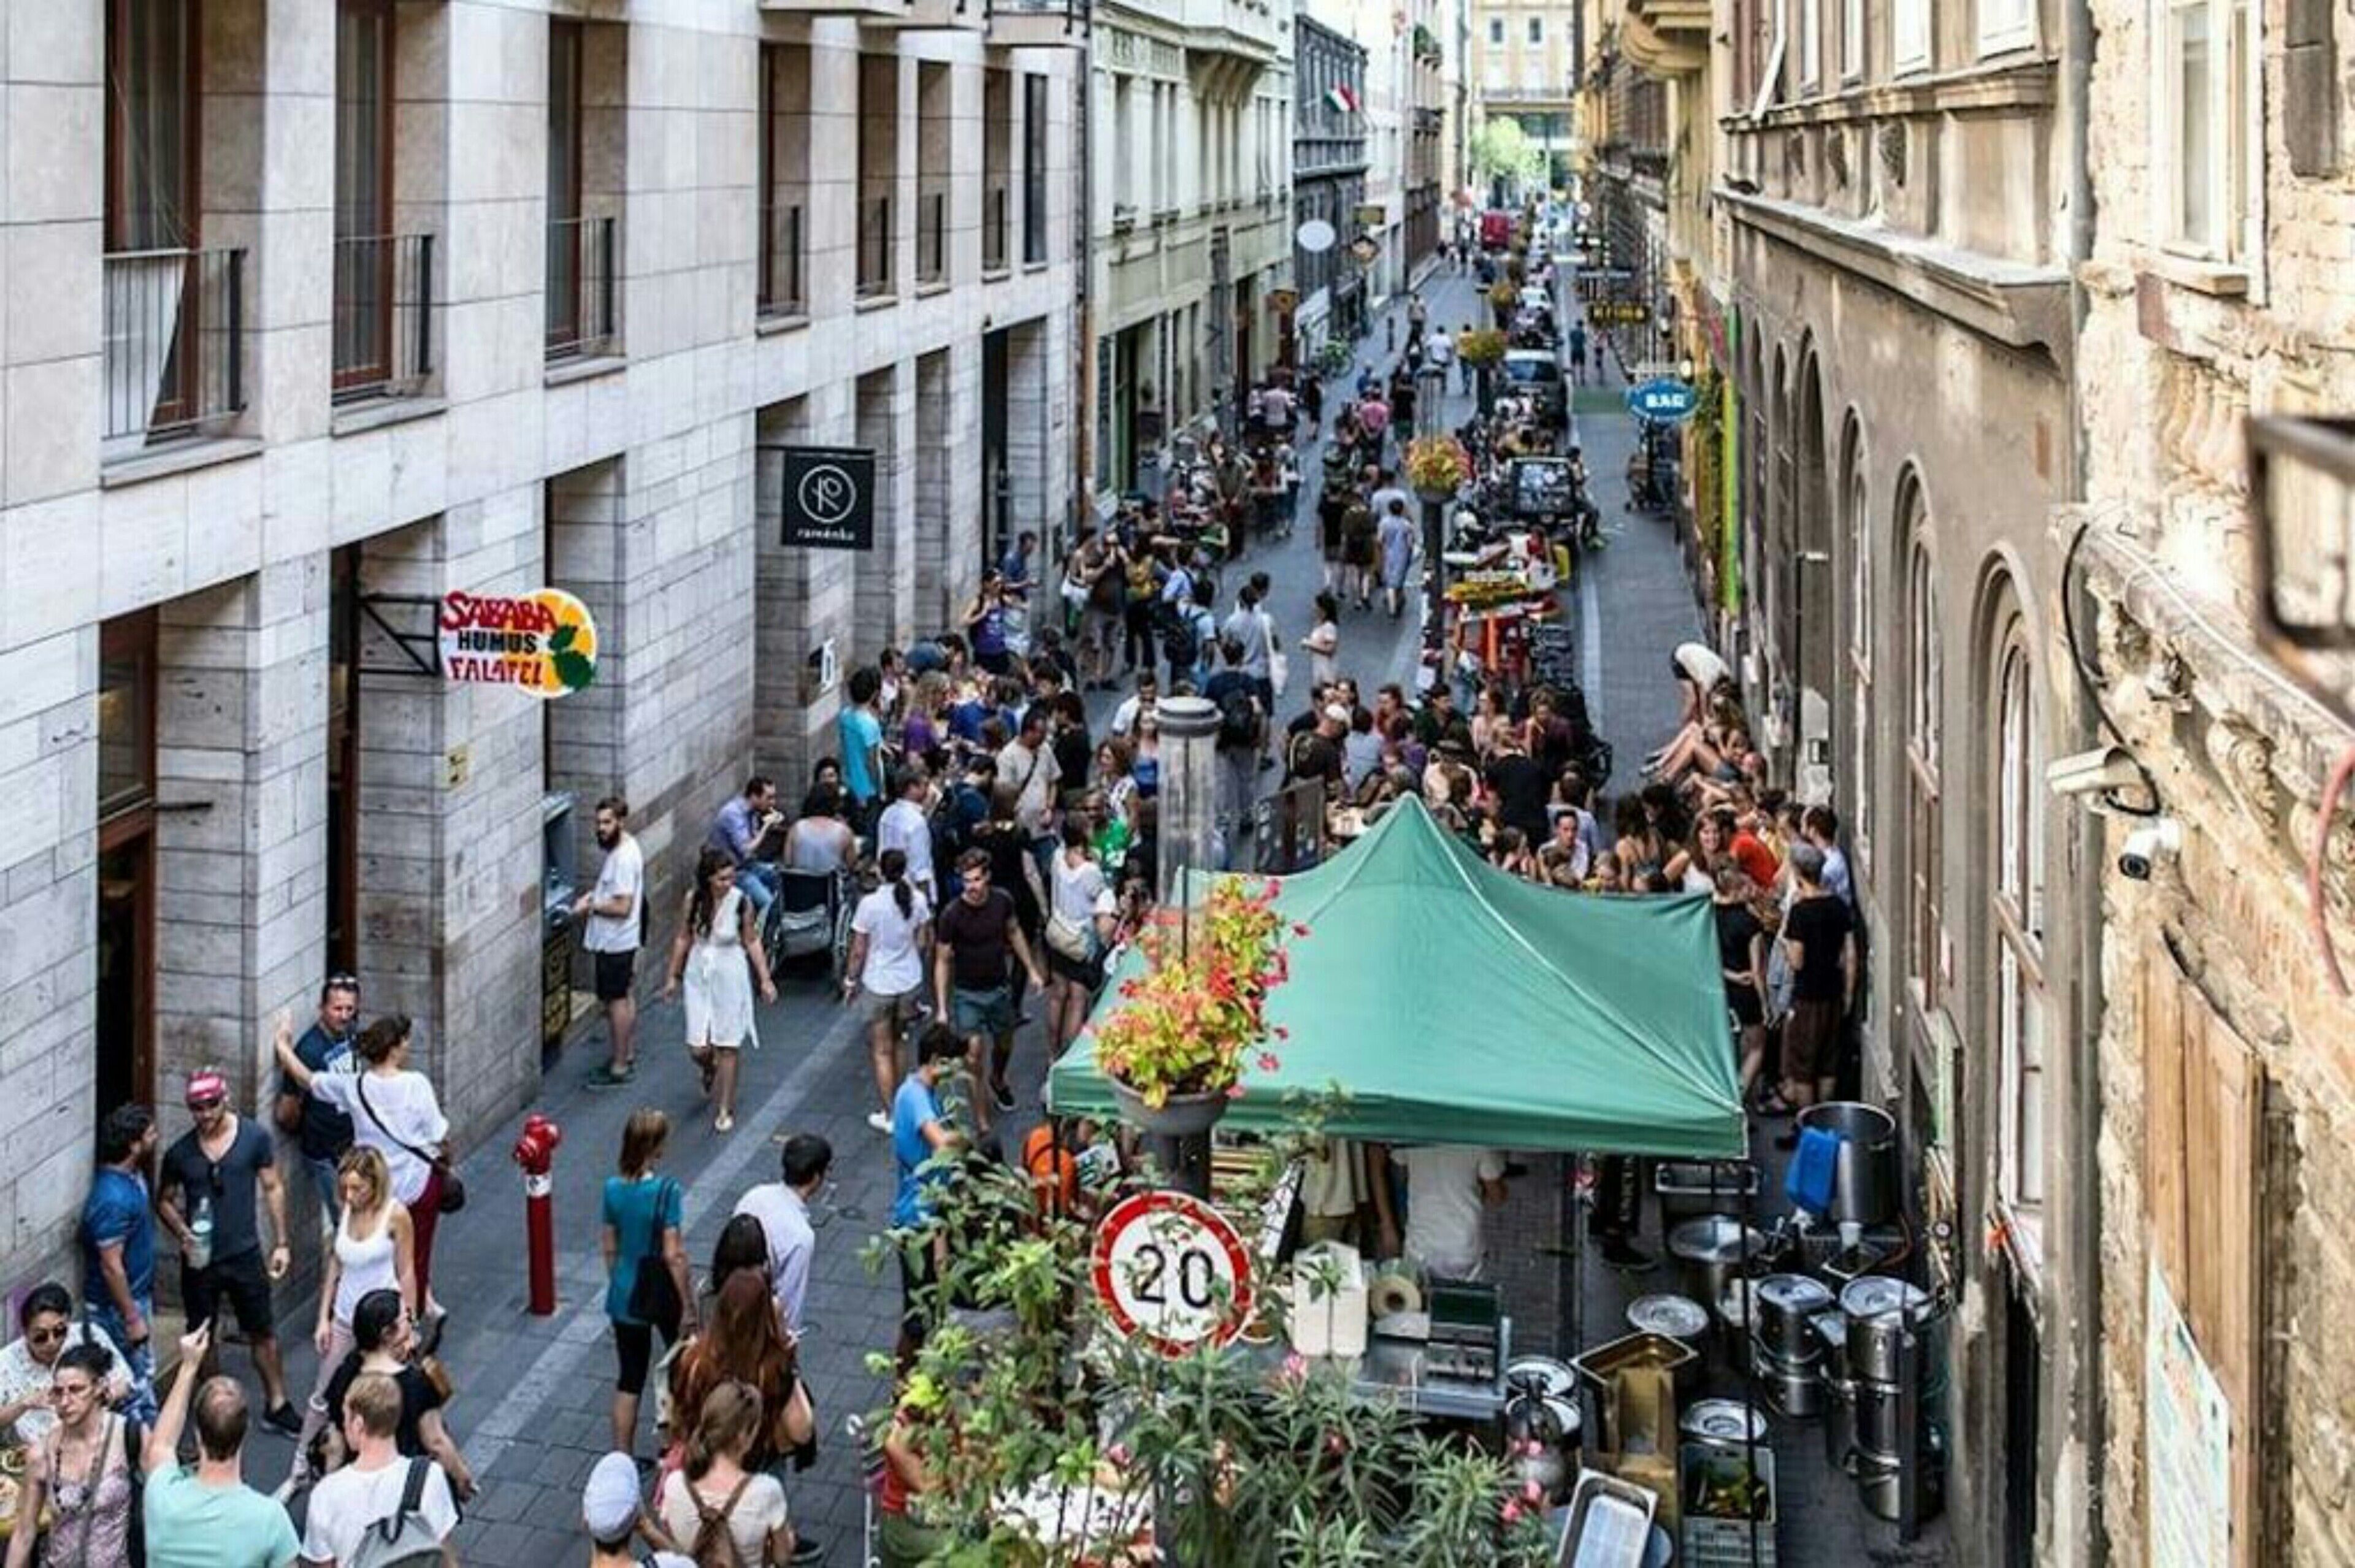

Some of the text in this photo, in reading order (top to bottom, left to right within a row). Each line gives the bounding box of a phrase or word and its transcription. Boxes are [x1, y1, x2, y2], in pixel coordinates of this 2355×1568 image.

[1646, 393, 1685, 408] BAR
[441, 591, 557, 632] SABABA
[458, 630, 537, 653] HUMUS
[450, 658, 542, 684] FALAFEL
[1135, 1244, 1214, 1309] 20
